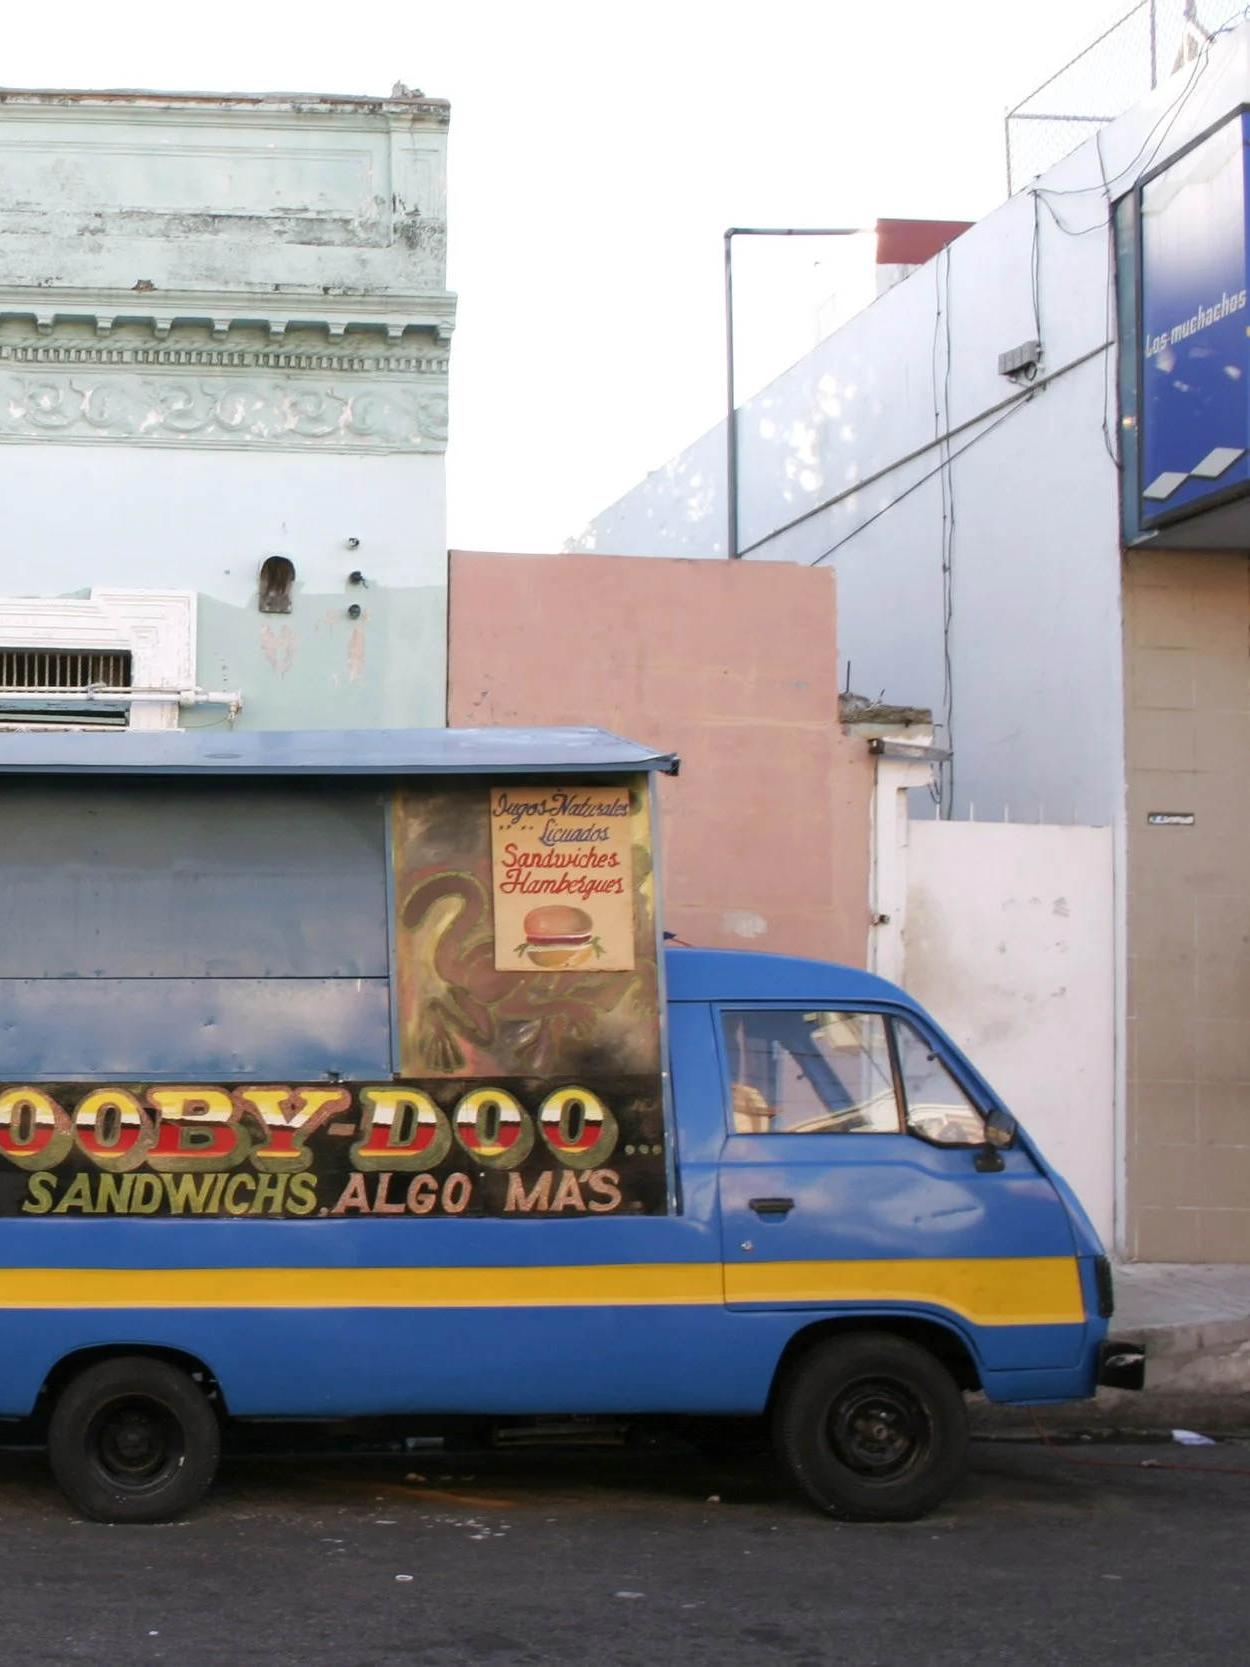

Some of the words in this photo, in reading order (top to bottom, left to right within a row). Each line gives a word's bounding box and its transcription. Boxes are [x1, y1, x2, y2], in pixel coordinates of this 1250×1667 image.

[1170, 289, 1247, 345] muchachos
[493, 793, 548, 824] Jugos
[549, 793, 628, 818] Naturales
[538, 818, 611, 846] Licuados
[501, 843, 621, 869] Sandwiches
[331, 1171, 472, 1215] ALGO
